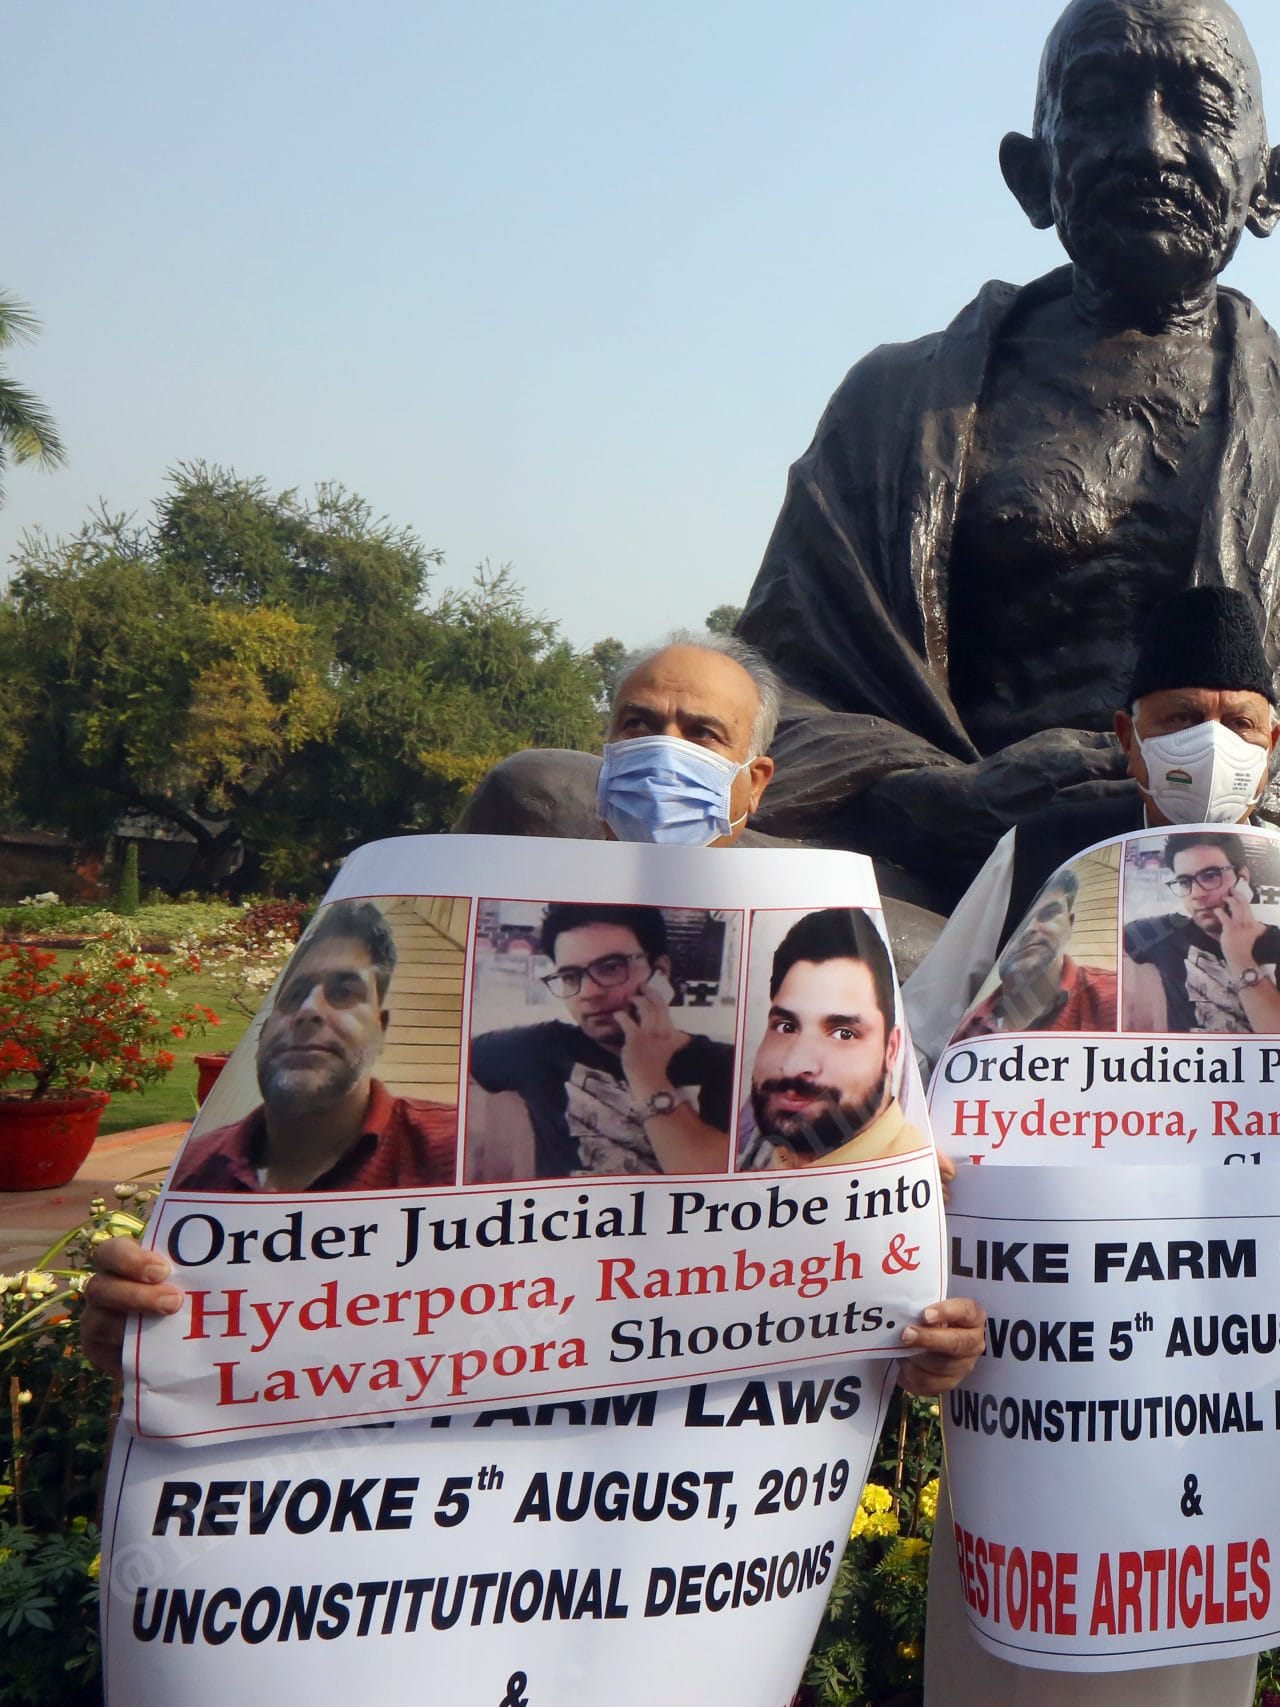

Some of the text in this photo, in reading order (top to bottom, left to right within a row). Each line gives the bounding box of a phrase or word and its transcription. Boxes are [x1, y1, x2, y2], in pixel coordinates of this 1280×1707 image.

[944, 1045, 1069, 1084] Order
[1081, 1046, 1245, 1092] Judicial
[951, 1098, 1198, 1149] Hyderpora,
[168, 1176, 931, 1267] Order Judicial Probe into
[952, 1237, 1069, 1283] LIKE
[1094, 1239, 1256, 1283] FARM
[182, 1232, 921, 1352] Hyderpora, Rambagh &
[213, 1302, 896, 1406] Lawaypora Shootouts.
[982, 1317, 1094, 1362] VOKE
[1109, 1311, 1154, 1361] 5th
[684, 1376, 862, 1427] LAWS
[951, 1388, 1263, 1442] UNCONSTITUTIONAL
[152, 1459, 849, 1537] REVOKE 5th AUGUST, 2019
[1181, 1474, 1203, 1517] &
[133, 1541, 833, 1645] UNCONSTITUTIONAL DECISIONS
[1090, 1538, 1270, 1636] ARTICLES
